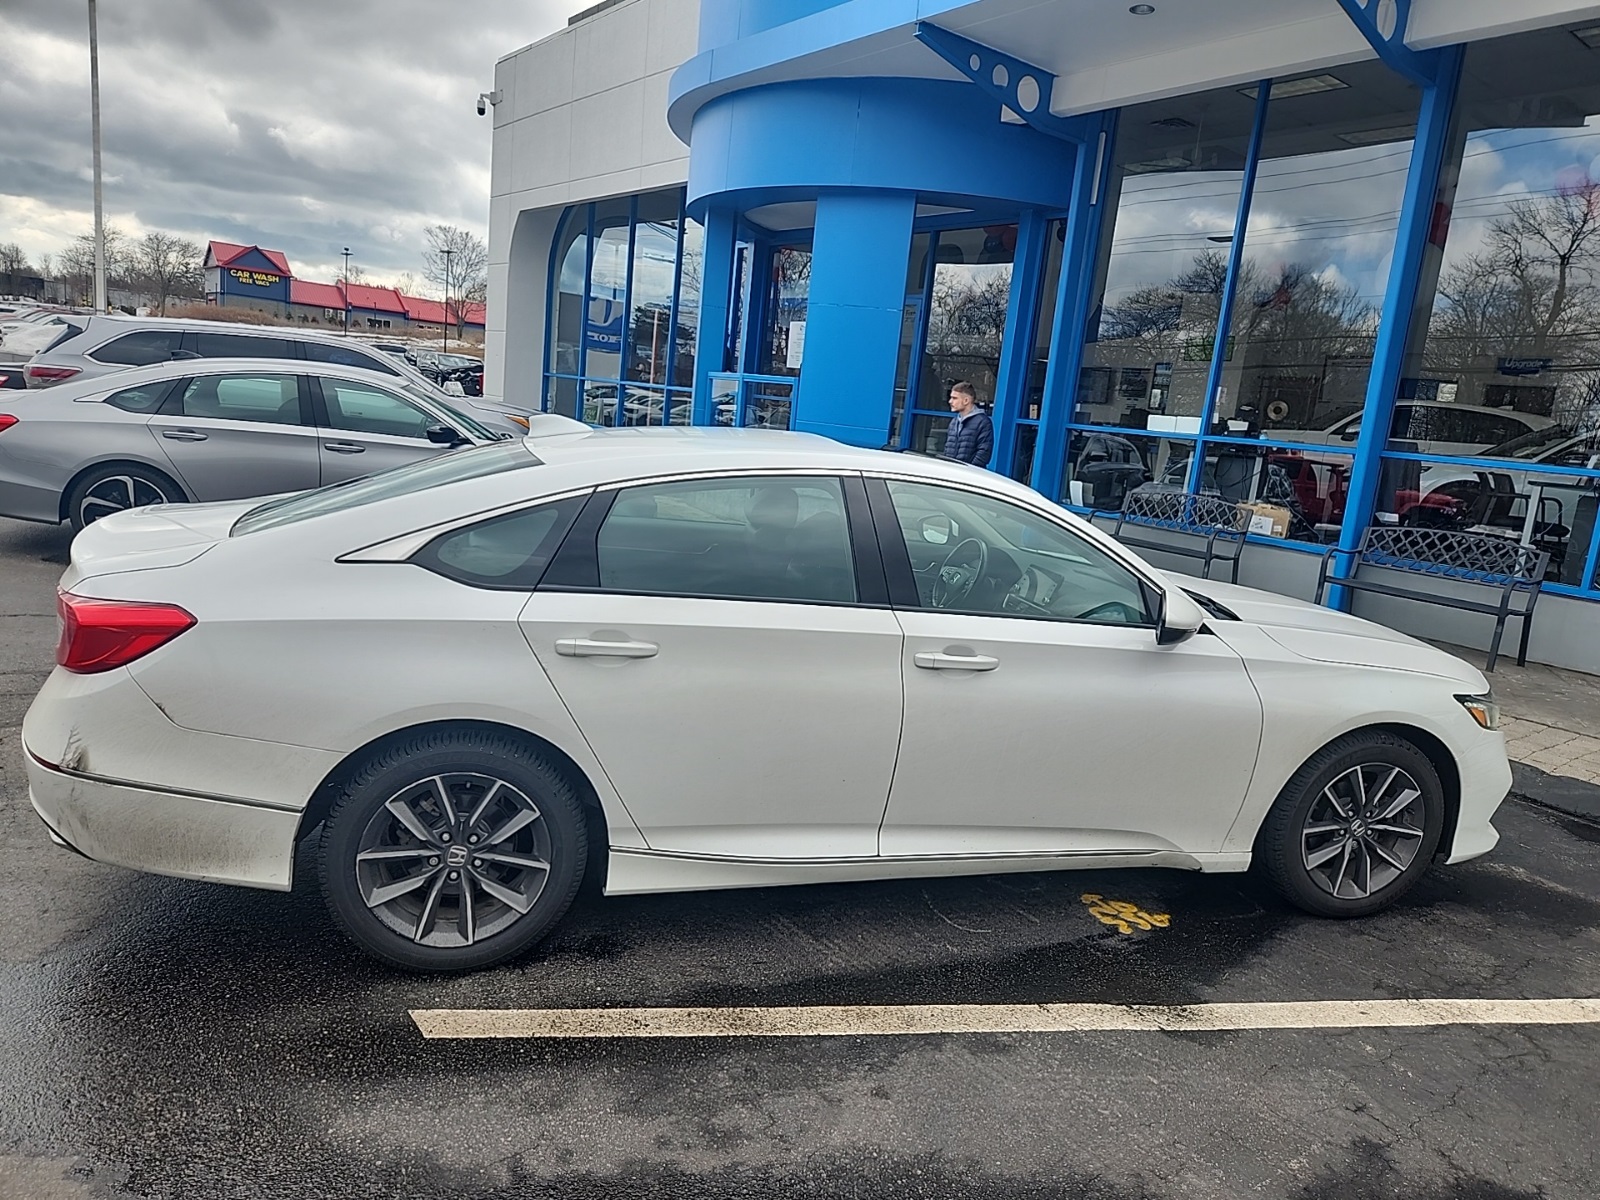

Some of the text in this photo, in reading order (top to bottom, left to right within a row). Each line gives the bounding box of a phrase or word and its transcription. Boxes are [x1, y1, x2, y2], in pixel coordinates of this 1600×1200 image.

[230, 269, 279, 283] CAR WASH
[1505, 357, 1542, 370] Upgrade
